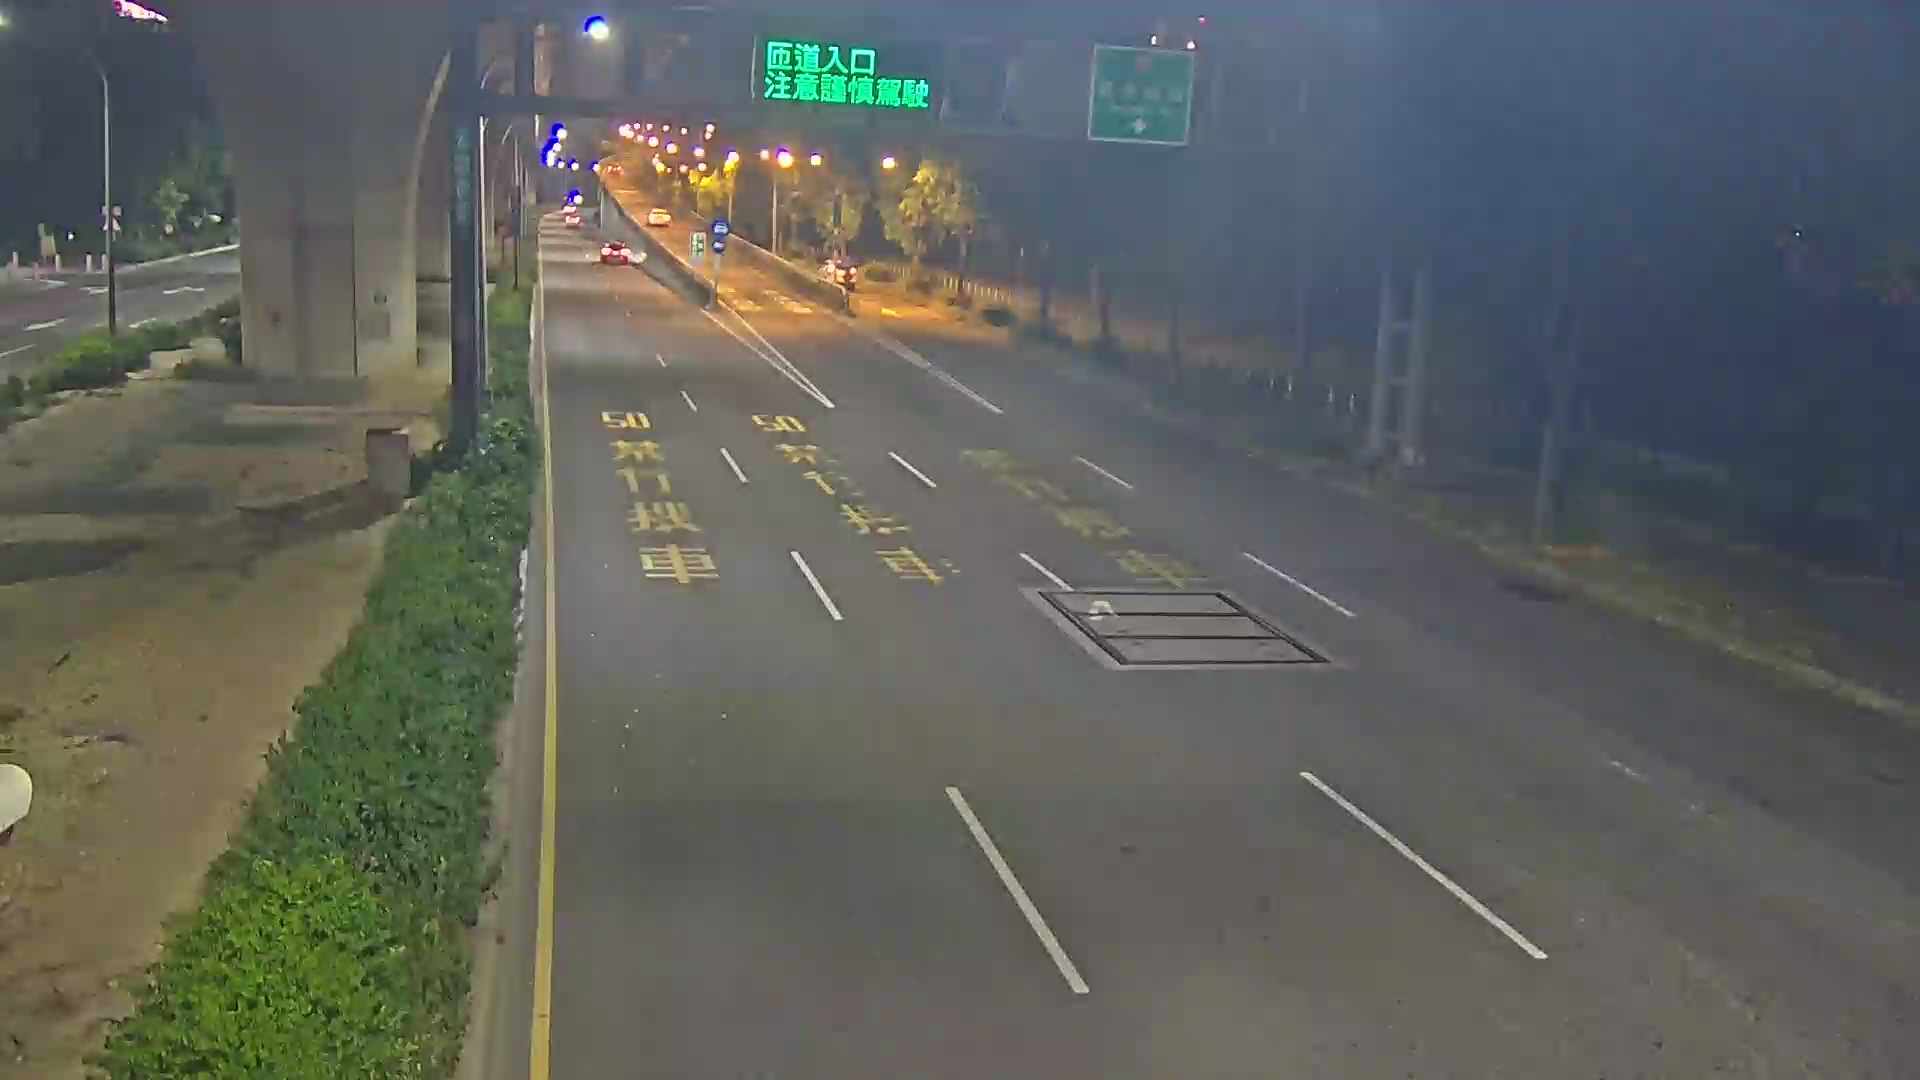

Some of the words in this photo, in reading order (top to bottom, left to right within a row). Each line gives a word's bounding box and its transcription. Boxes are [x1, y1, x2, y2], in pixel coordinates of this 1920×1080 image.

[767, 41, 876, 75] 匝道入口
[764, 71, 929, 108] 注意謹慎駕駛
[601, 411, 651, 429] 50
[752, 414, 807, 432] 50
